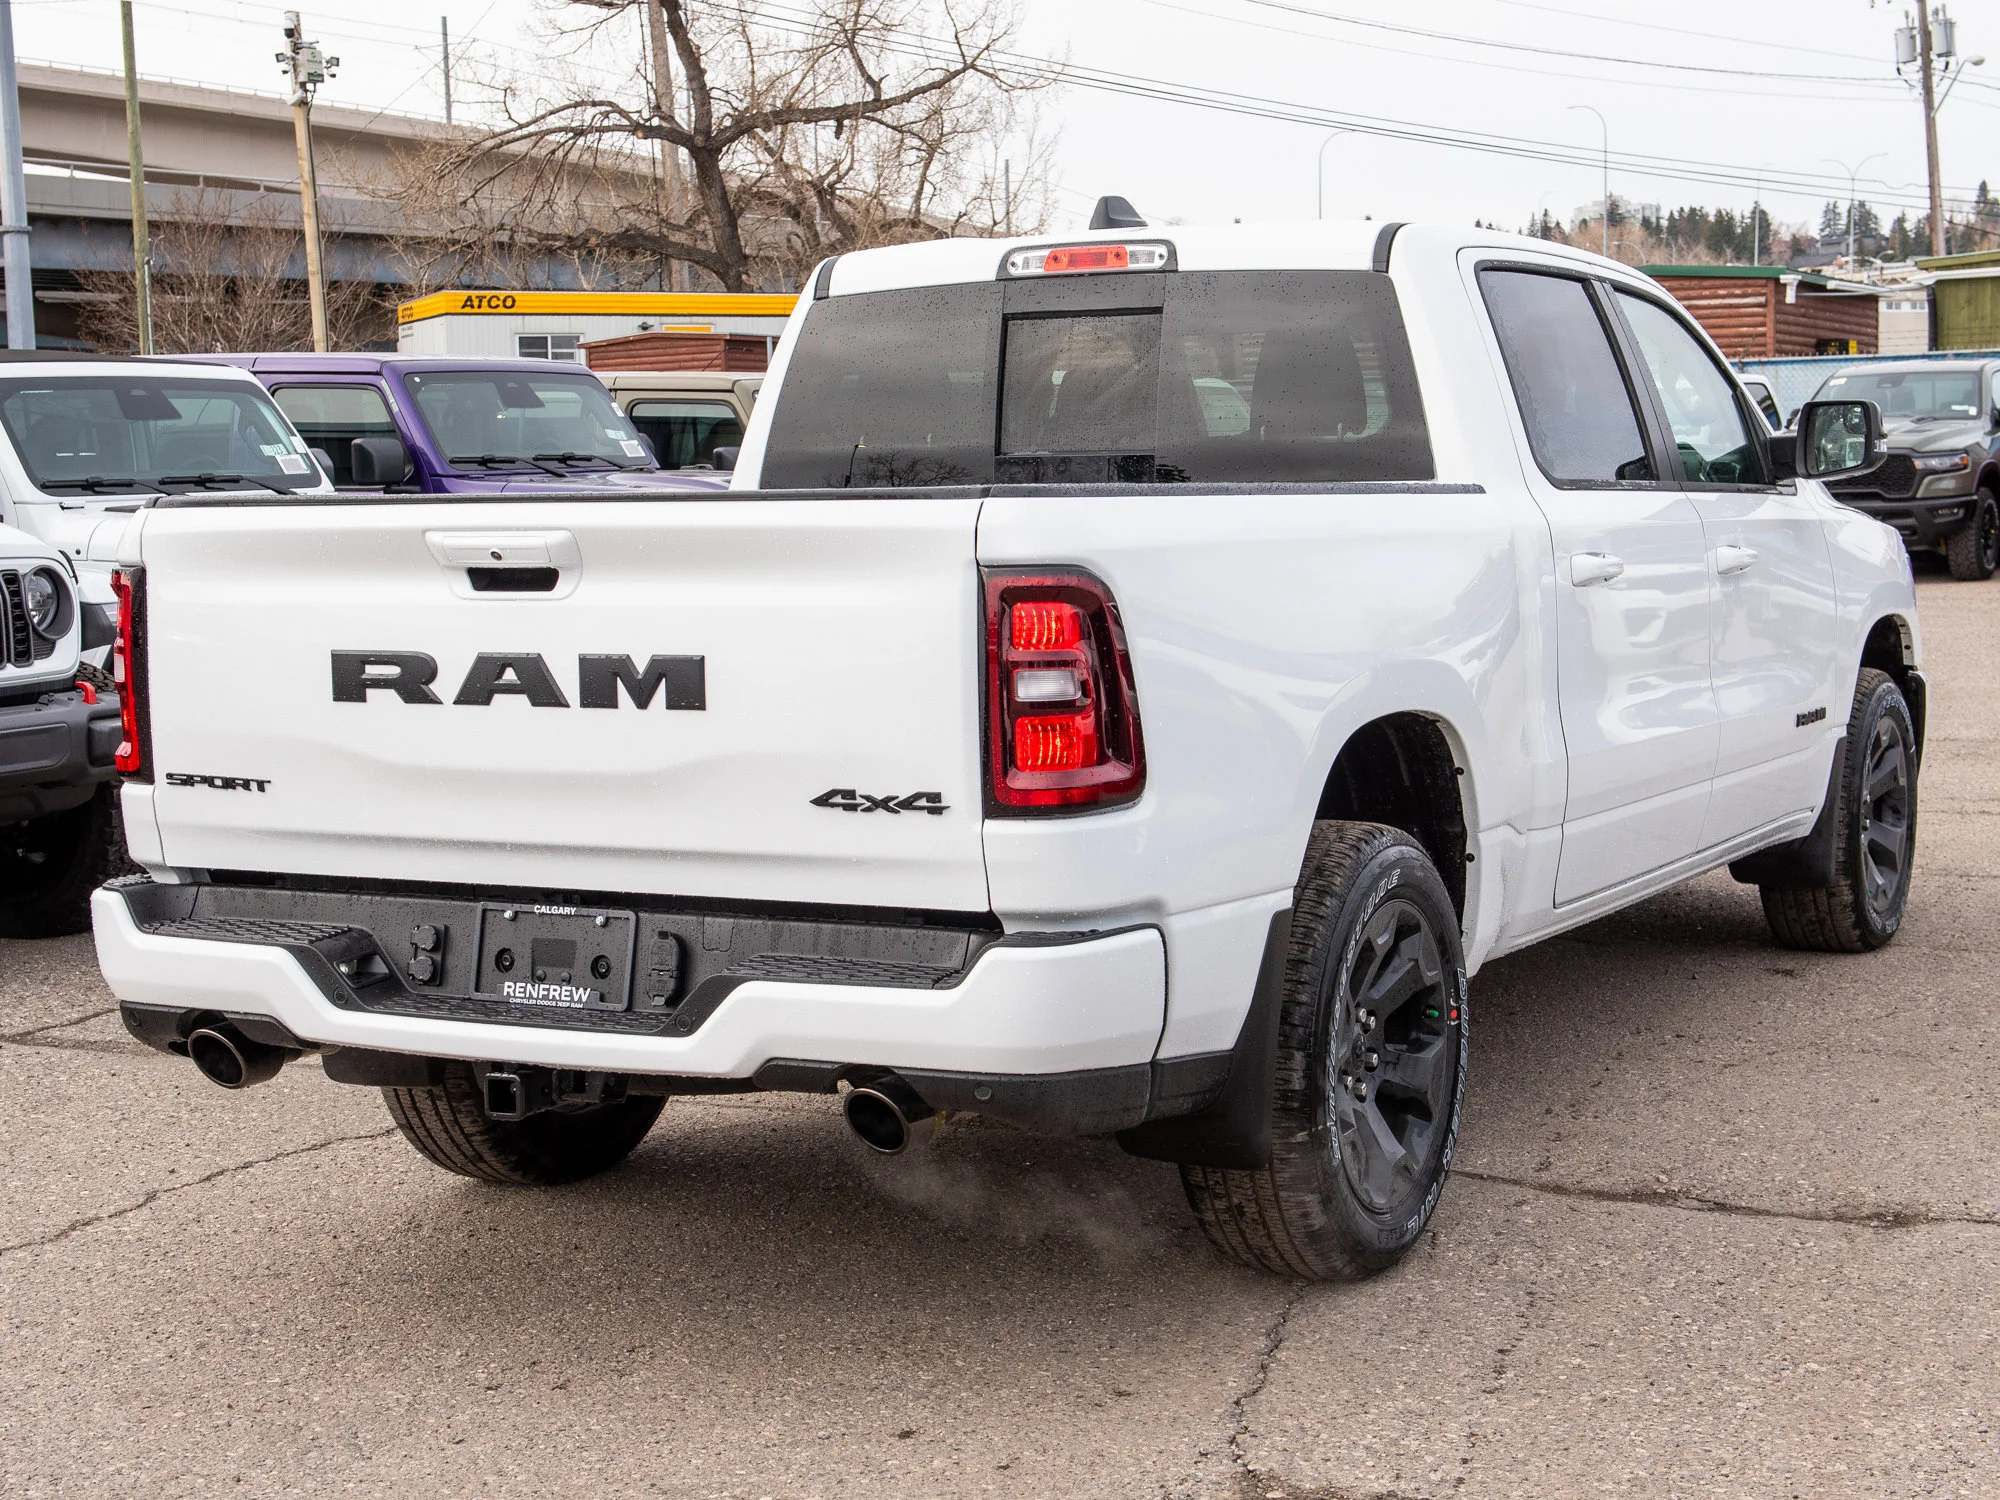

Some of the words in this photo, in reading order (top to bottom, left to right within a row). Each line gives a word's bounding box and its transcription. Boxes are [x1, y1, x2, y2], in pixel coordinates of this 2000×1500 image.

[461, 295, 517, 310] ATCO
[331, 649, 707, 711] RAM
[1796, 706, 1827, 728] RAM
[165, 772, 272, 793] SPORT
[534, 904, 577, 916] CALGARY
[503, 981, 591, 1003] RENFREW
[509, 997, 537, 1005] CHRYSLER
[536, 999, 557, 1007] DODGE
